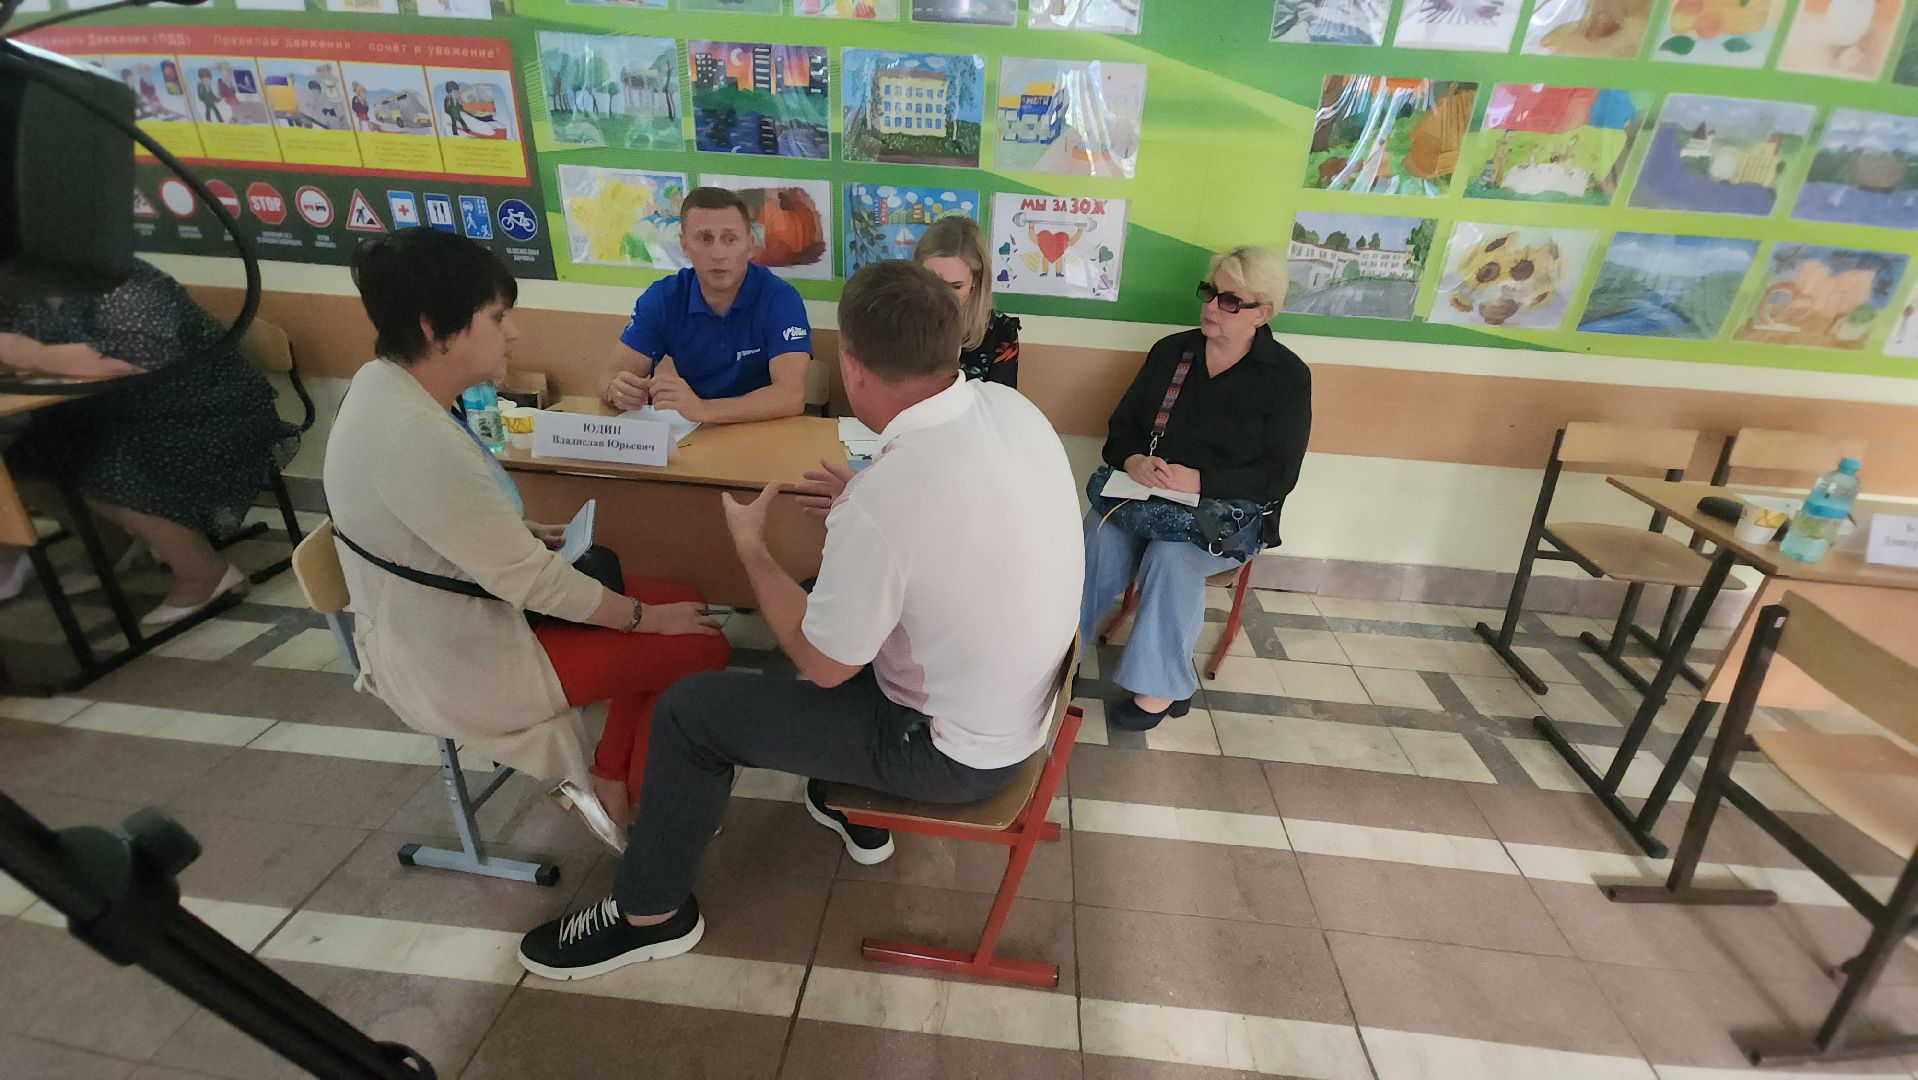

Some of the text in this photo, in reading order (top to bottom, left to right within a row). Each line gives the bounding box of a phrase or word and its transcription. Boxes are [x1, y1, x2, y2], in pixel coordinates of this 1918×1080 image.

[153, 32, 191, 47] (ПДД)
[285, 37, 351, 49] движения
[250, 195, 281, 212] STOP
[1020, 197, 1108, 215] МЫ ЗА ЗОЖ
[583, 422, 621, 435] ЮДИН
[552, 434, 655, 451] Владислав Юрьевич
